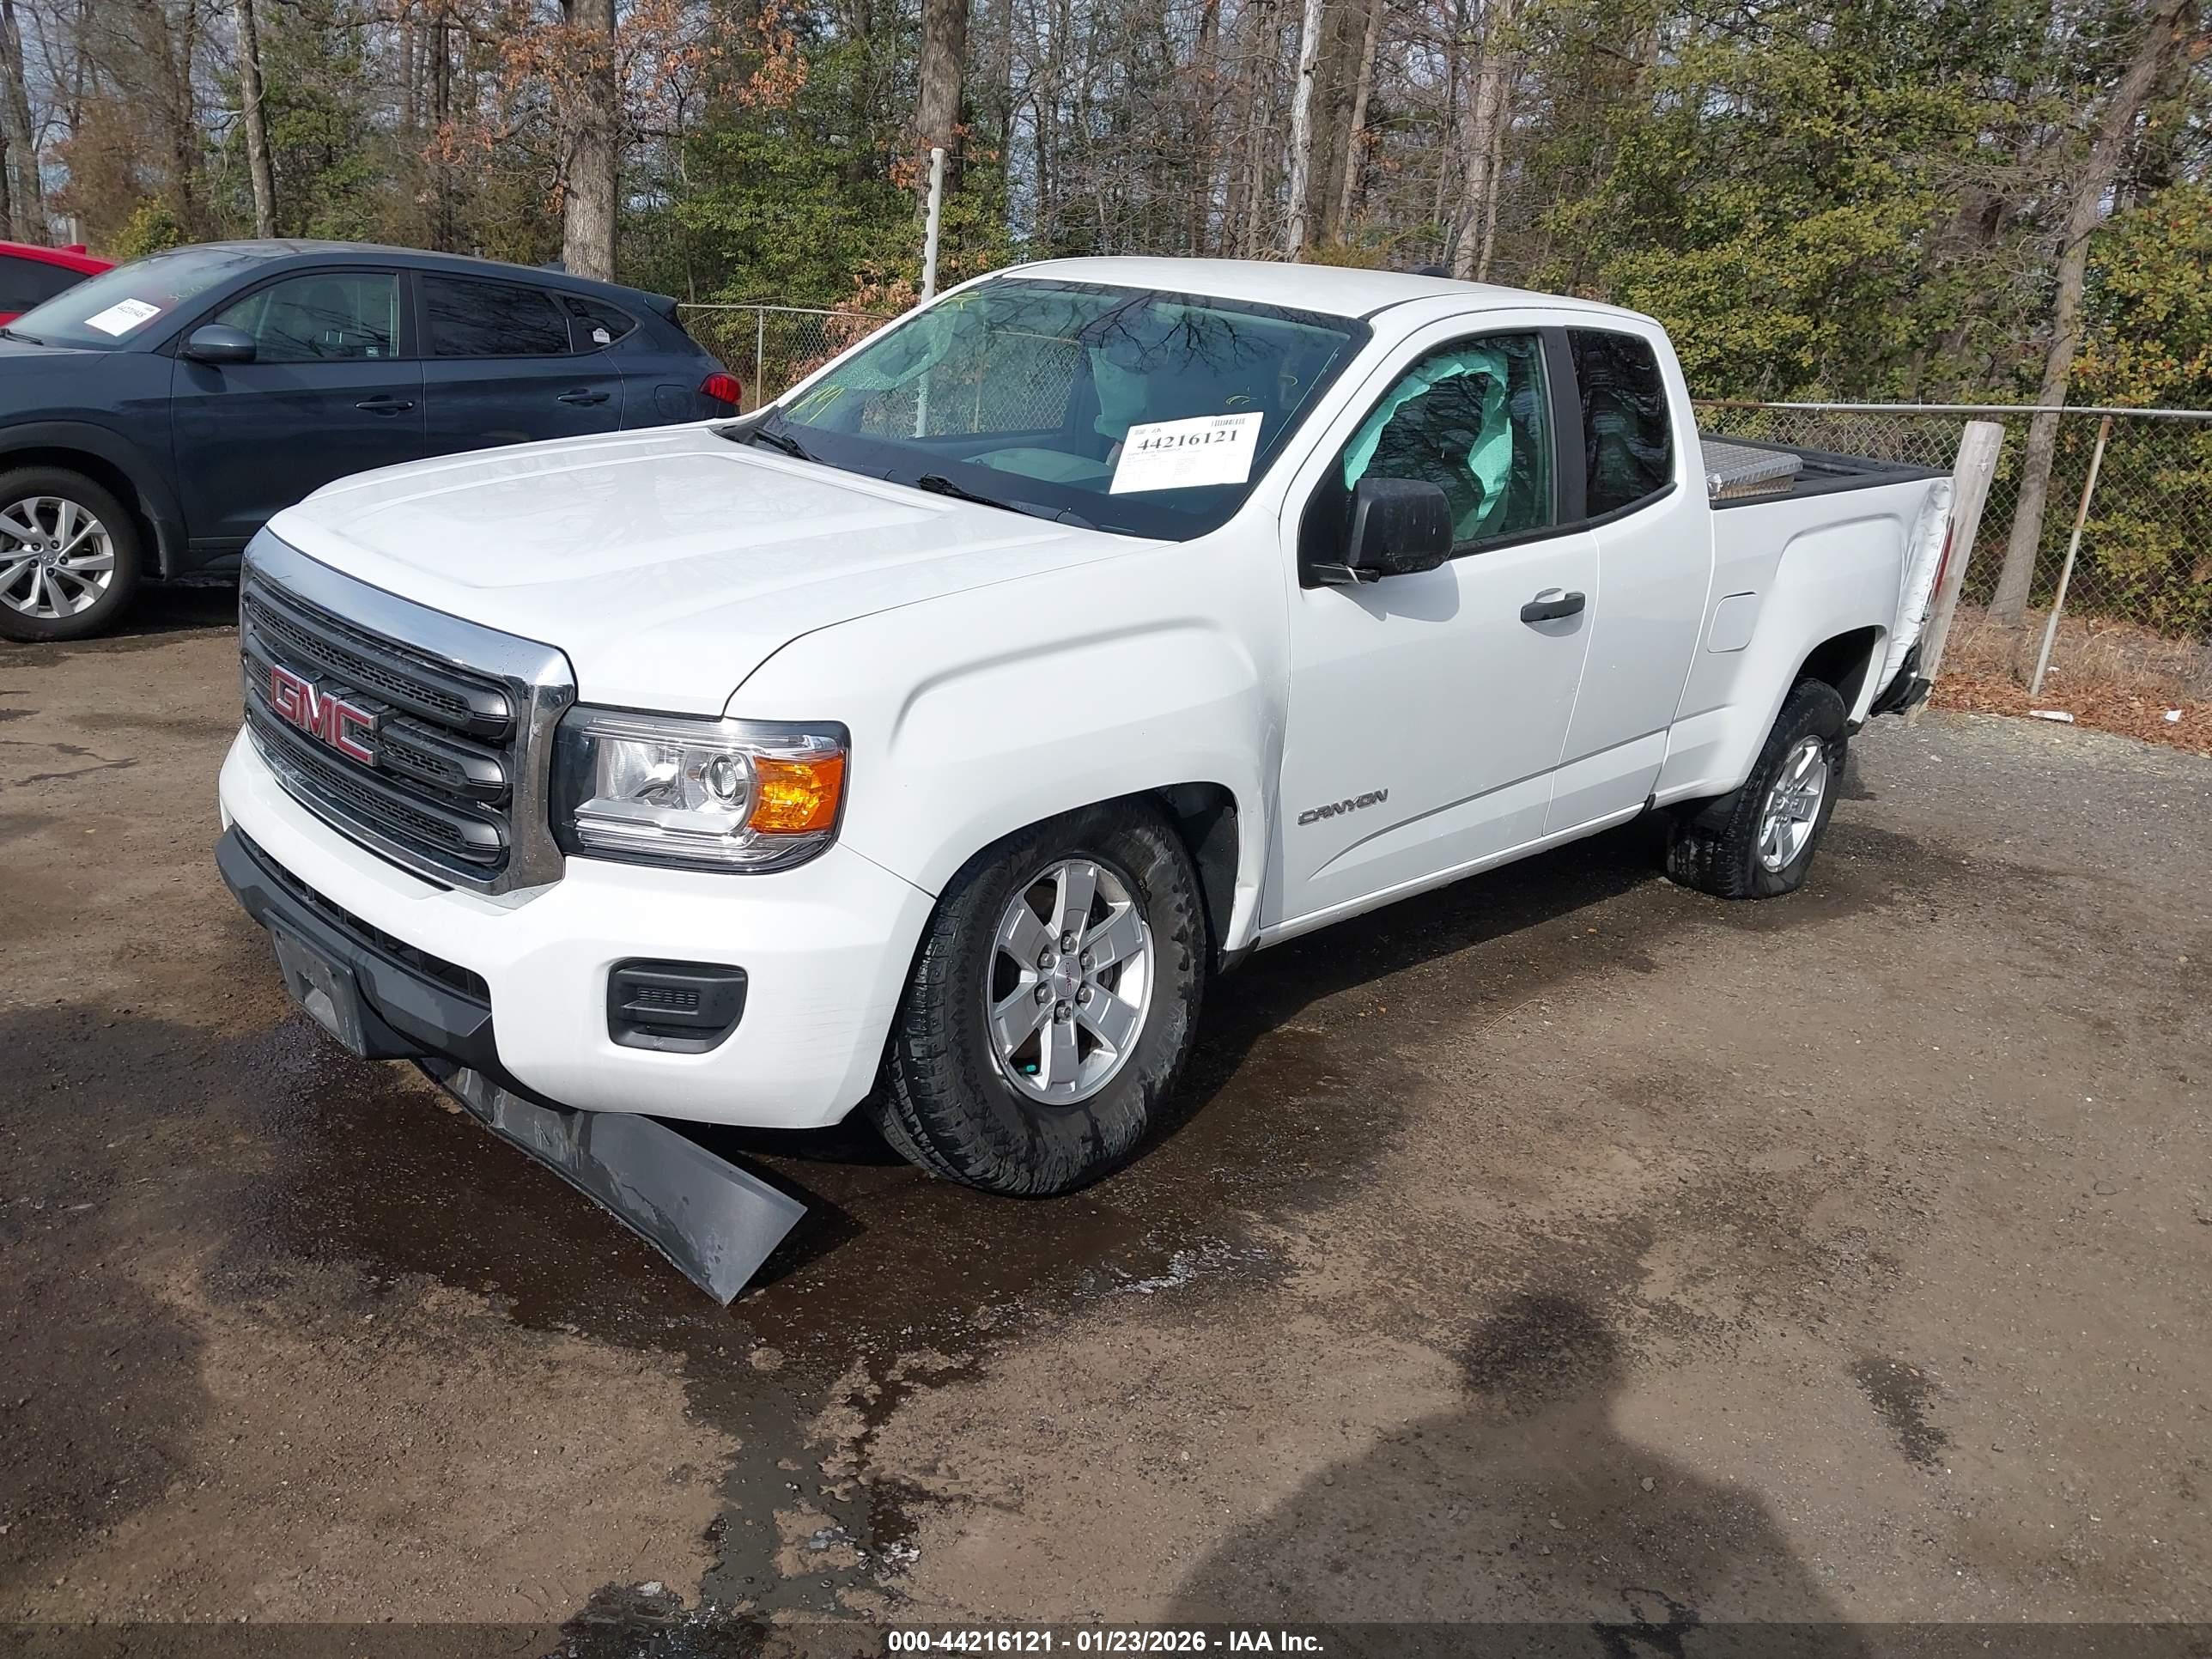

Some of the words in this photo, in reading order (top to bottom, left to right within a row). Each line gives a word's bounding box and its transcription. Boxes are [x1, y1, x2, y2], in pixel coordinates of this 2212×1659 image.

[1137, 429, 1238, 450] 44216121
[270, 664, 379, 767] GMC
[1297, 787, 1389, 826] CANYON
